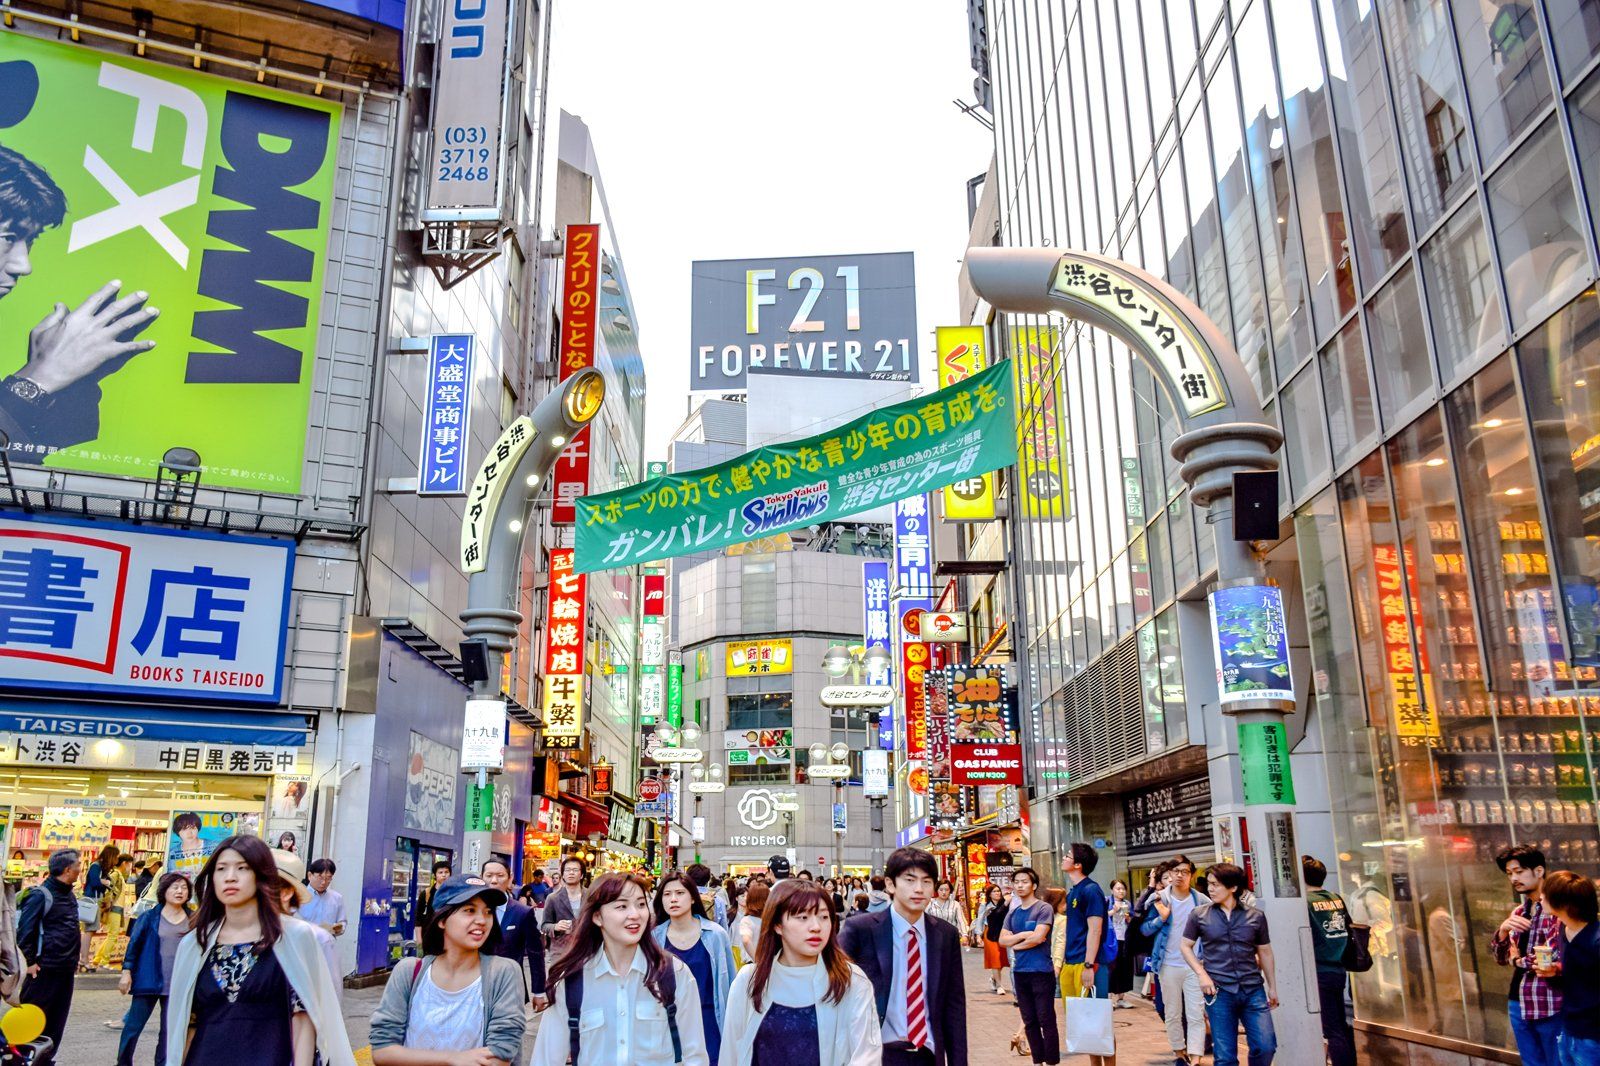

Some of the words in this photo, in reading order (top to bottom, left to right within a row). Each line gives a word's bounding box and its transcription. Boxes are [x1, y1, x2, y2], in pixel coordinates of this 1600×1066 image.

[440, 149, 489, 164] 3719
[445, 127, 487, 145] (03)
[68, 61, 208, 271] FX
[438, 167, 489, 181] 2468
[184, 90, 331, 385] DMM
[566, 232, 593, 371] クスリのことな
[787, 265, 861, 333] 21
[1063, 263, 1206, 401] 渋谷センター街
[698, 341, 867, 377] FOREVER
[876, 338, 911, 371] 21
[429, 344, 465, 484] 大盛堂商事ビル
[586, 382, 1006, 527] スポーツの力で、健やかな青少年の育成を。
[465, 424, 524, 566] 渋谷センター街
[765, 491, 794, 505] Tokyo
[794, 481, 828, 498] Yakult
[838, 445, 982, 512] 渋谷センター街
[953, 478, 983, 495] 4F
[602, 508, 735, 565] ガンバレ！
[645, 589, 664, 601] JTB
[551, 574, 581, 672] 七輪焼肉
[1262, 596, 1278, 647] 九十九島
[130, 665, 184, 682] BOOKS
[193, 669, 265, 688] TAISEIDO
[550, 677, 575, 726] 牛繁
[15, 717, 145, 736] TAISEIDO
[464, 725, 499, 738] 九十九島
[0, 738, 81, 764] ト渋谷
[973, 748, 998, 756] CLUB
[1263, 725, 1285, 801] 客引きは犯罪です
[422, 768, 455, 800] PEPSI
[1146, 787, 1175, 815] BOOK
[730, 834, 787, 846] ITS'DEMO
[1276, 819, 1292, 881] 防犯カメラ作動中
